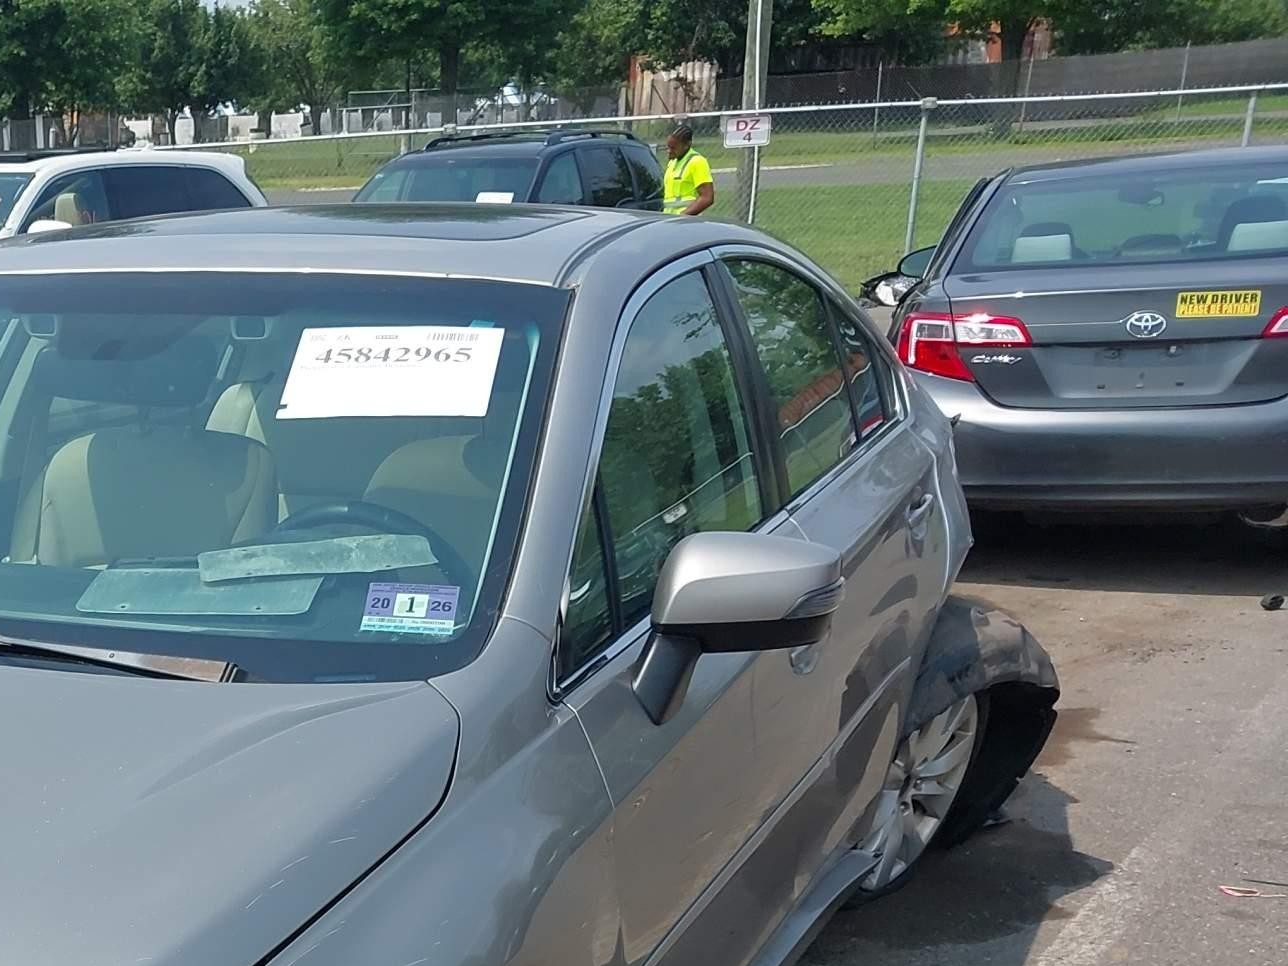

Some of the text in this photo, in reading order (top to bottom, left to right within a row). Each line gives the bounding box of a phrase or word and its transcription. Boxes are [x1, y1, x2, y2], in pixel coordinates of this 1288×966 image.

[736, 119, 760, 131] DZ
[743, 132, 752, 143] 4
[1180, 292, 1258, 305] NEW DRIVER
[1179, 303, 1257, 315] PLEASE BE PATIENT
[315, 346, 473, 364] 45842965
[370, 596, 453, 613] 20 1 26
